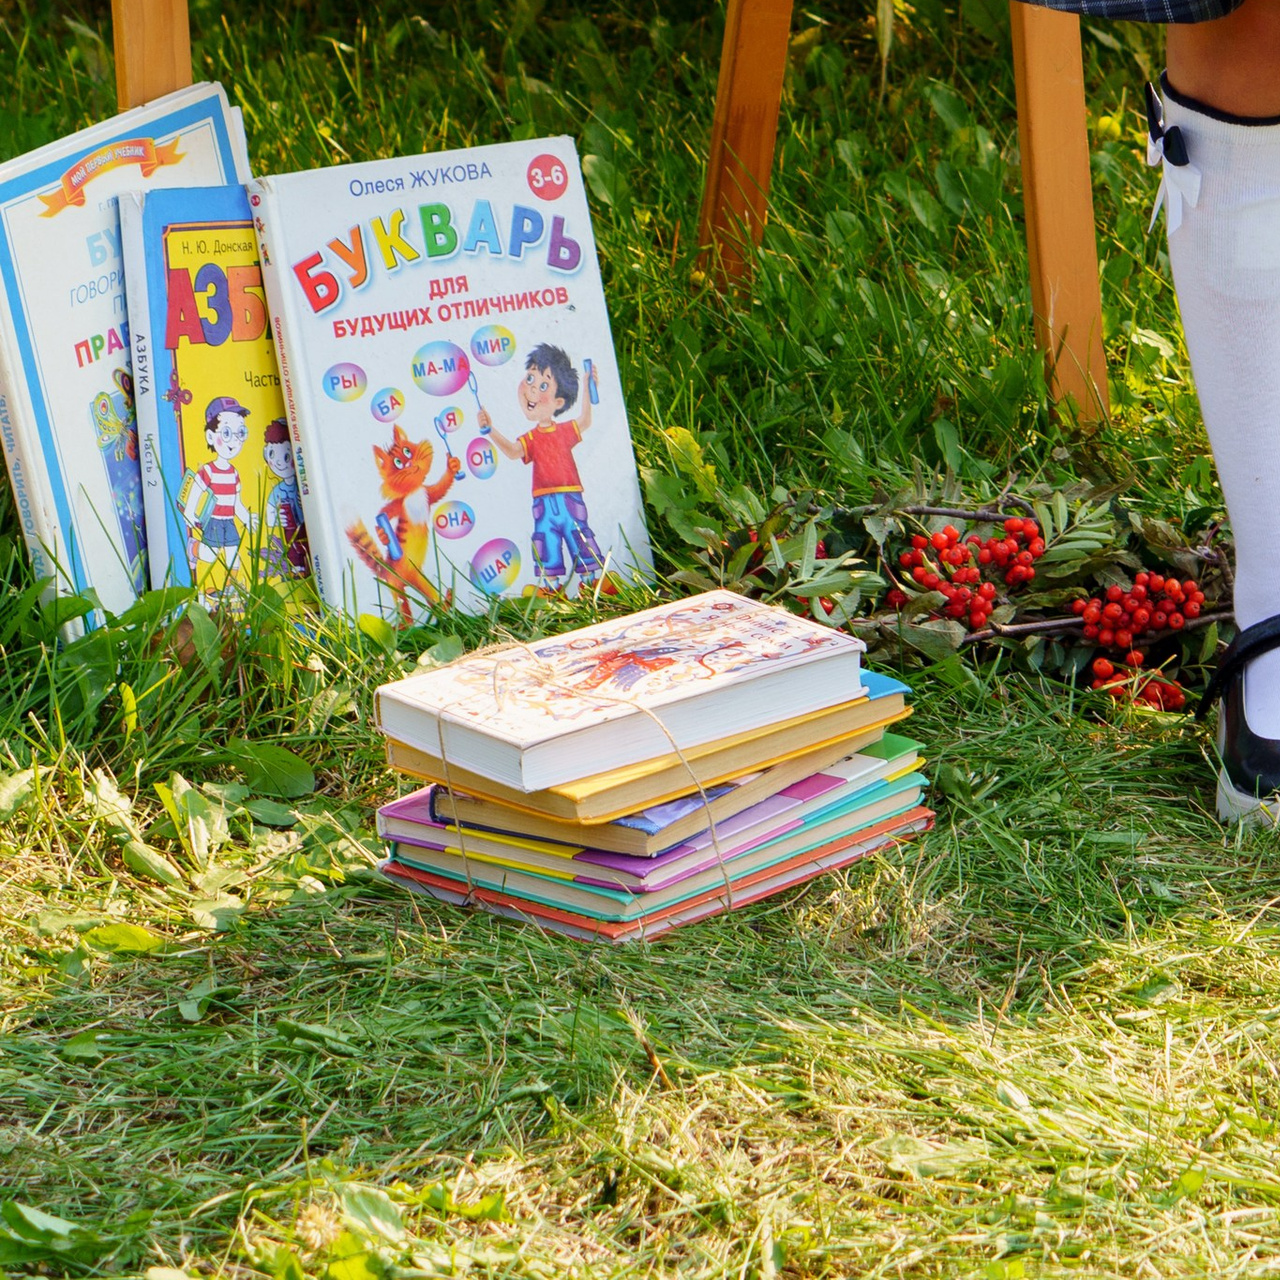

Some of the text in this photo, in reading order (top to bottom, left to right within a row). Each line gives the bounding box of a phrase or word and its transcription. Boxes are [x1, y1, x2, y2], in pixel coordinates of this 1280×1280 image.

[350, 161, 493, 197] Олеся ЖУКОВА
[530, 165, 565, 188] 3-6
[182, 240, 253, 255] Н. Ю. Донская
[291, 198, 582, 313] БУКВАРЬ
[428, 275, 469, 300] ДЛЯ
[165, 263, 273, 349] АЗБ
[333, 287, 569, 339] БУДУЩИХ ОТЛИЧНИКОВ
[274, 316, 290, 377] ОТЛИЧНИКОВ
[476, 337, 511, 356] МИР
[245, 371, 280, 387] Часть
[412, 356, 469, 378] МА-МА
[330, 374, 358, 390] РЫ
[135, 334, 150, 395] АЗБУКА
[143, 433, 154, 473] Часть
[285, 379, 297, 422] БУДУЩИХ
[377, 395, 402, 416] БА
[446, 413, 457, 427] Я
[470, 449, 494, 467] ОН
[296, 446, 309, 496] БУКВАРЬ
[435, 510, 473, 529] ОНА
[480, 550, 513, 584] ШАР
